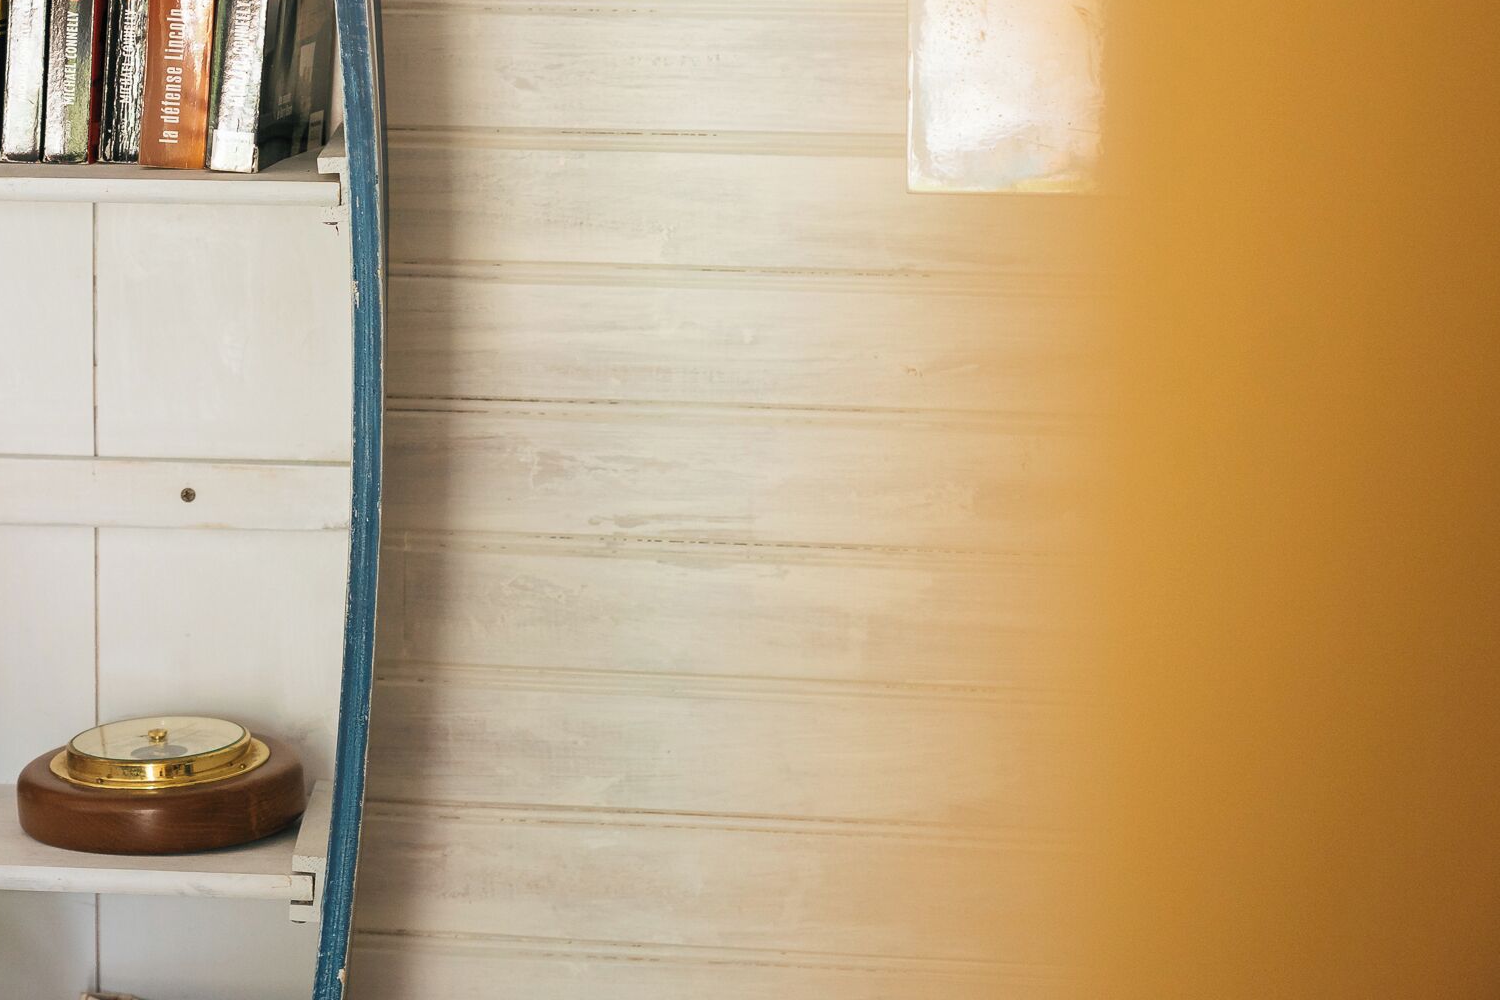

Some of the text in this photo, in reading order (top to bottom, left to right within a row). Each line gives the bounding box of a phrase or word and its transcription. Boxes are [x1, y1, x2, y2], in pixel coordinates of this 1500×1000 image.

[66, 10, 79, 61] CONNELLY
[63, 63, 78, 105] MICHAEL
[159, 7, 184, 144] la défense Lincoln
